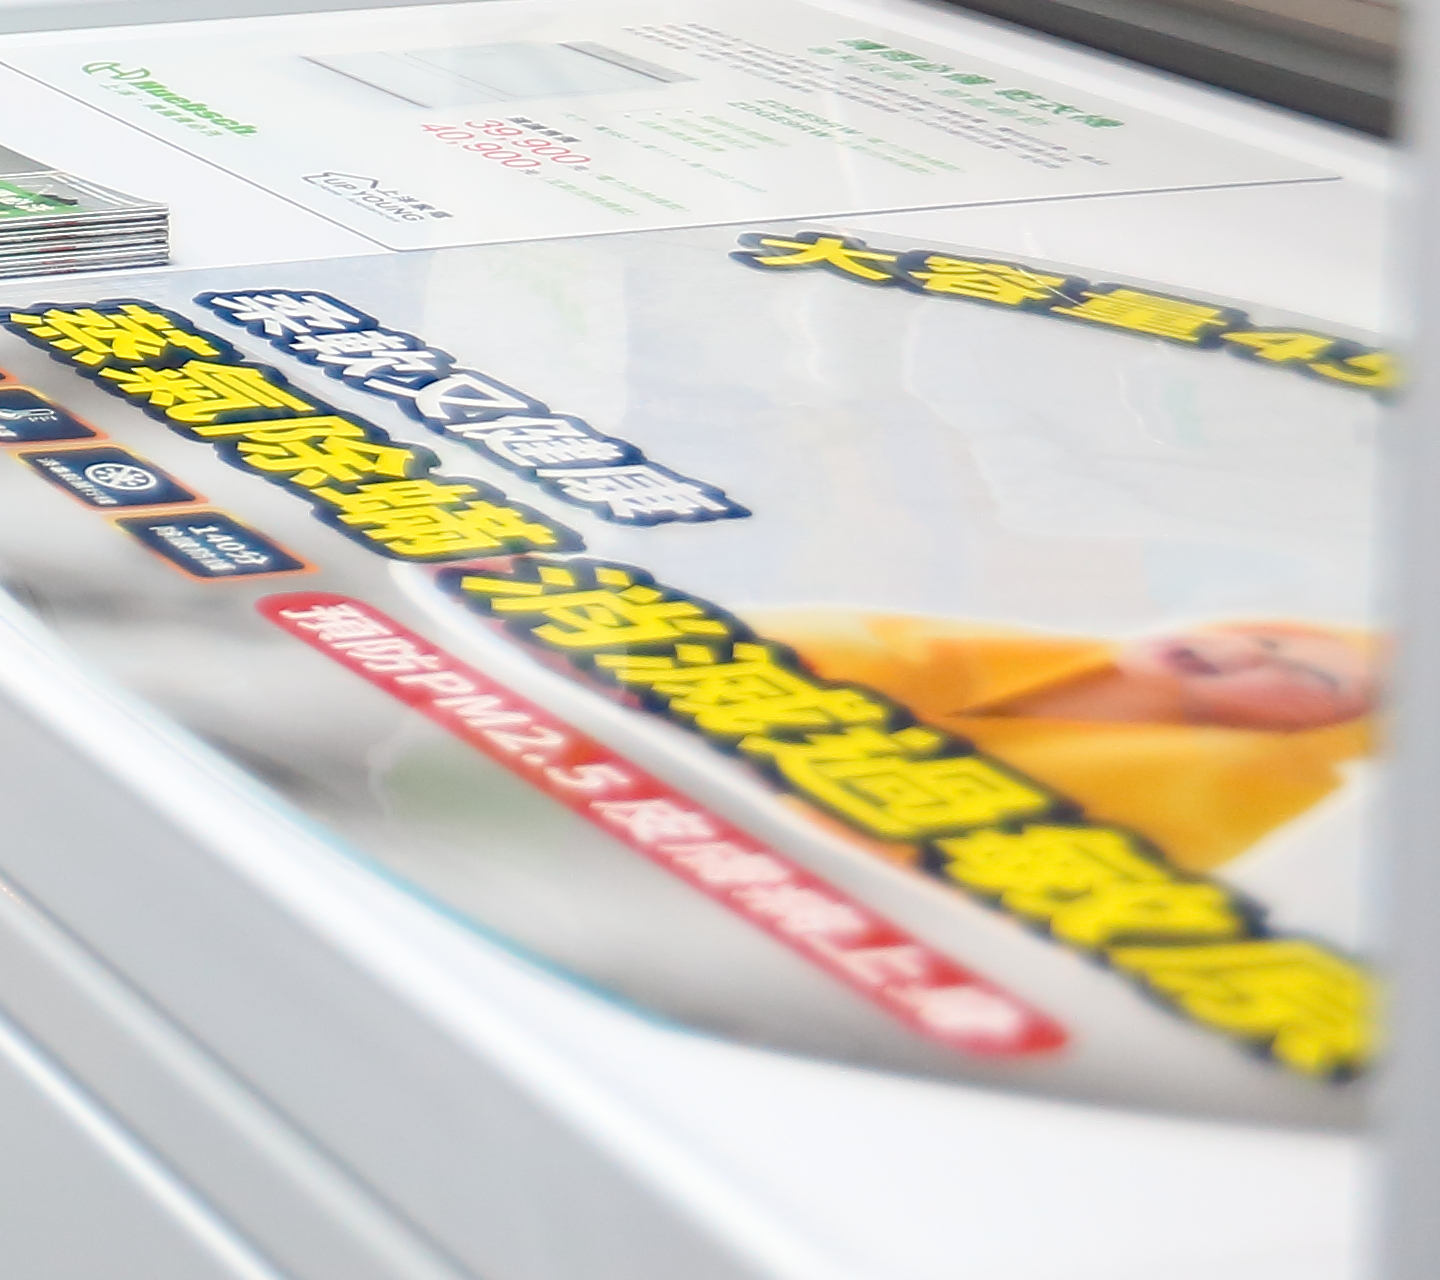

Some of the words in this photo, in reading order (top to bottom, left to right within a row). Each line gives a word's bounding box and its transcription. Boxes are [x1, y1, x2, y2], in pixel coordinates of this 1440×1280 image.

[134, 79, 257, 139] Huebsch
[420, 121, 543, 171] 40,900
[464, 117, 592, 166] 39,900
[6, 300, 574, 558] 蒸氣除蟎
[210, 289, 738, 522] 柔軟又健康
[188, 524, 268, 567] 140分
